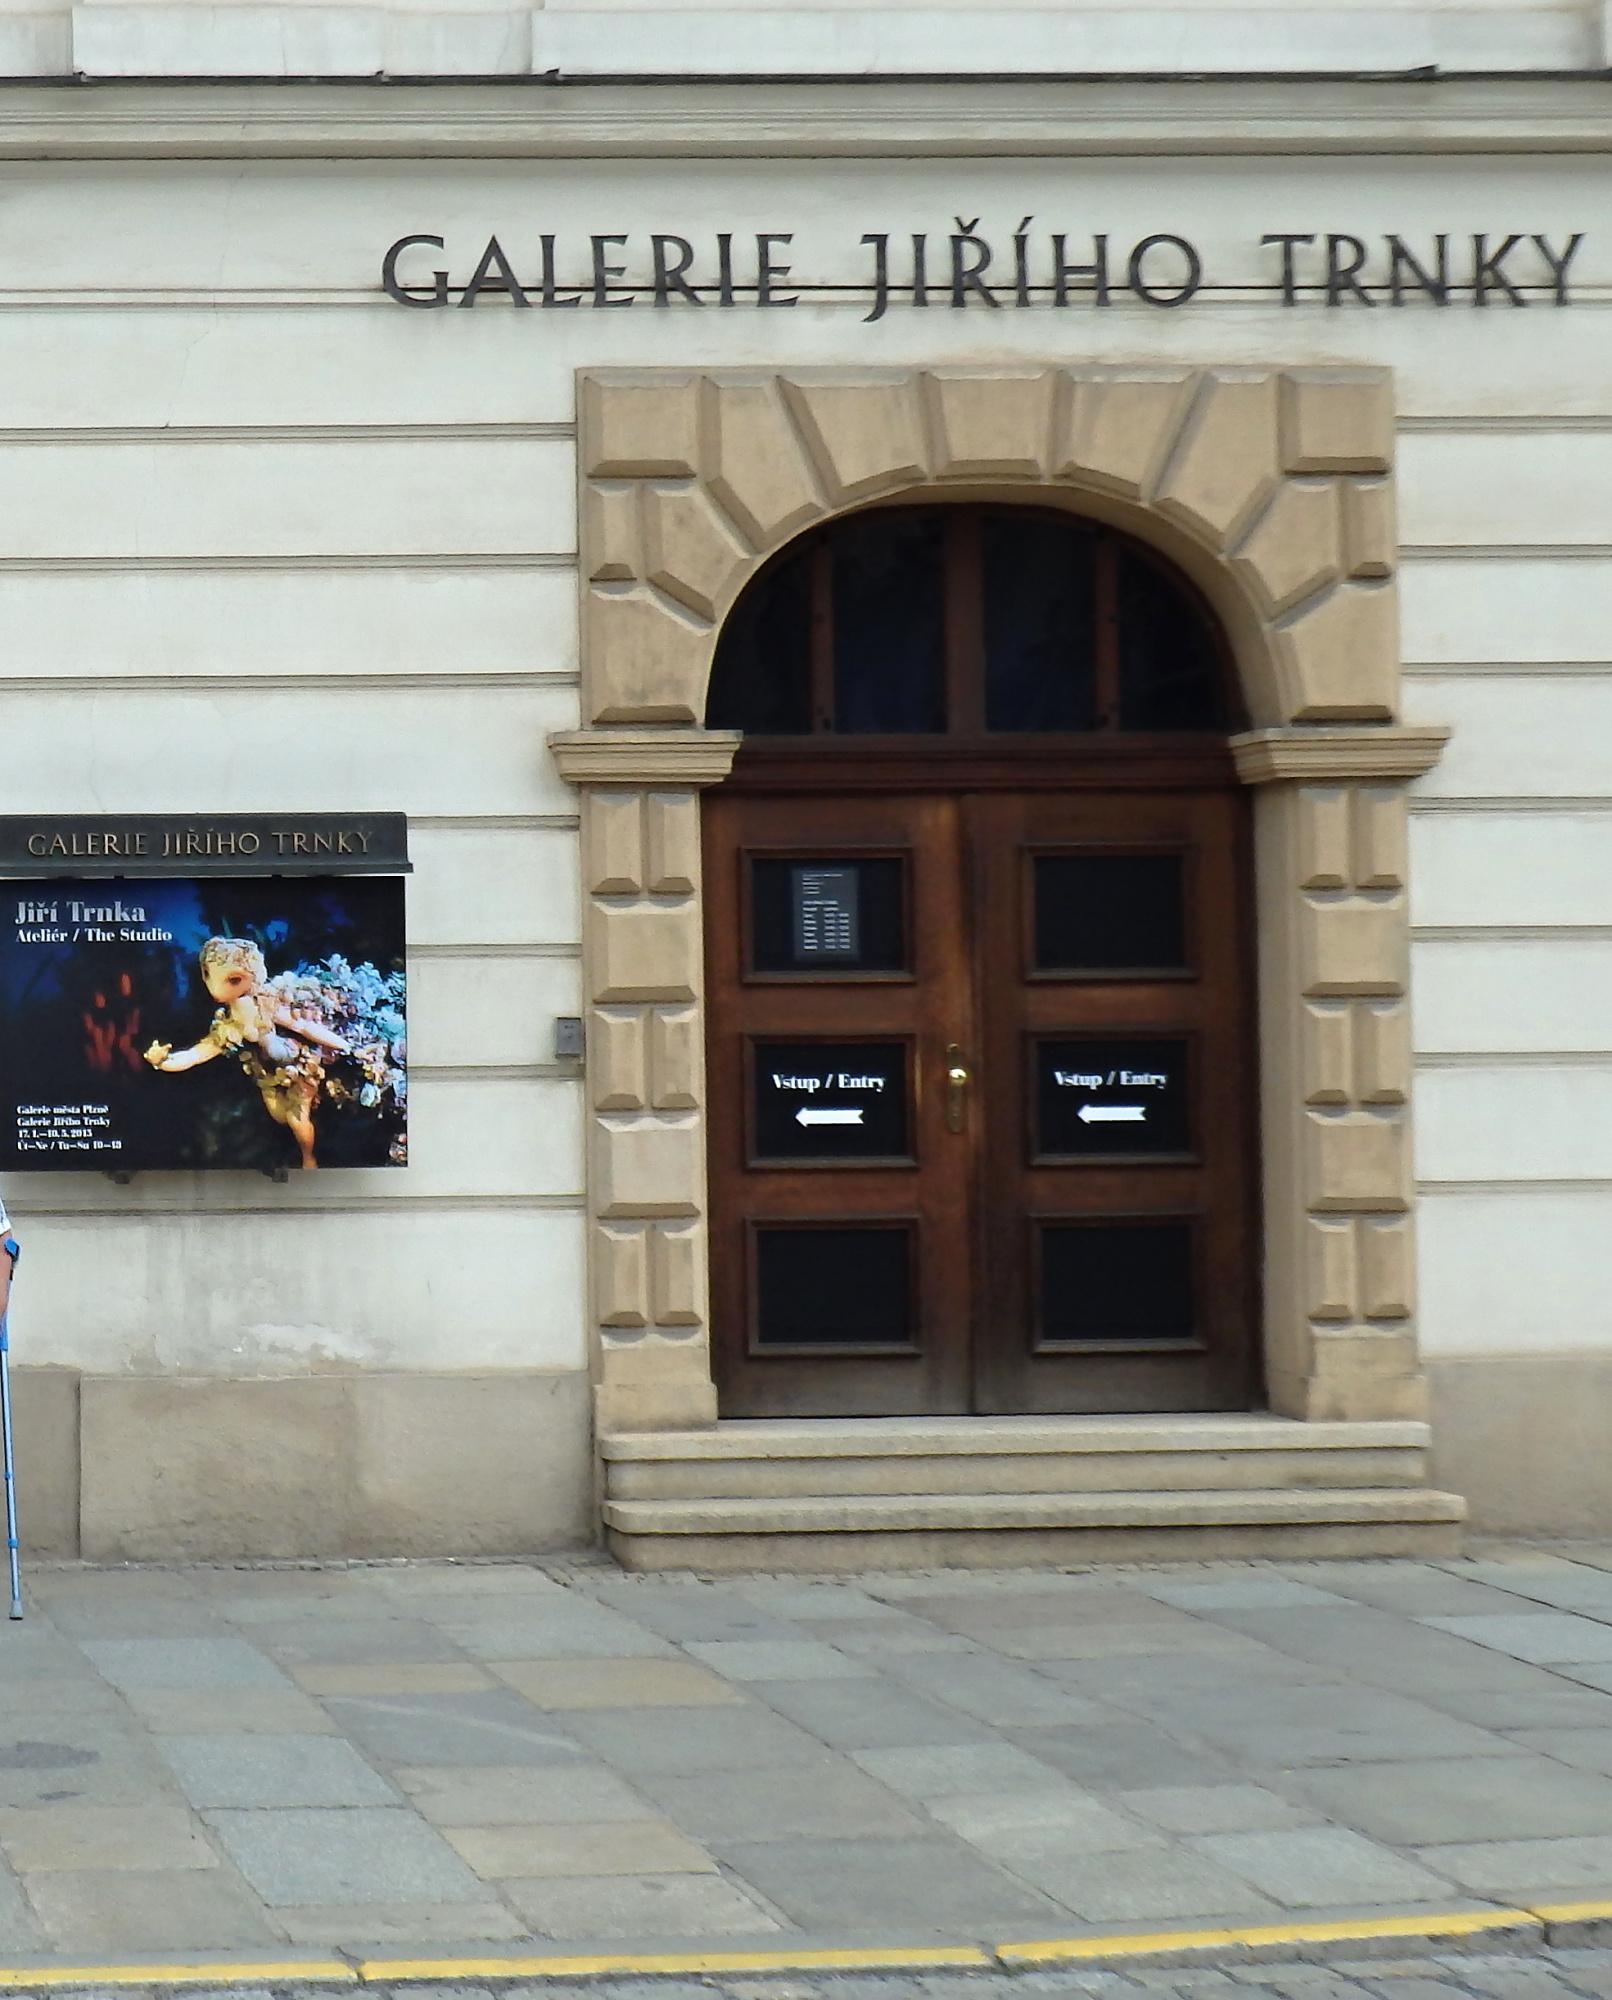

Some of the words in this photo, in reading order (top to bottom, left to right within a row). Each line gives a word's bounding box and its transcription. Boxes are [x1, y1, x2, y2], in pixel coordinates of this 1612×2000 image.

[382, 233, 801, 309] GALERIE
[859, 215, 1202, 323] JIŘÍHO
[1259, 232, 1586, 307] TRNKY
[28, 833, 149, 856] GALERIE
[161, 828, 261, 857] JIŘÍHO
[271, 831, 373, 854] TRNKY
[15, 901, 58, 925] Jiří
[66, 901, 147, 923] Trnka
[16, 928, 69, 943] Ateliér
[72, 928, 81, 943] /
[84, 928, 116, 942] The
[119, 928, 173, 942] Studio
[772, 1074, 821, 1093] Vstup
[824, 1074, 834, 1089] /
[838, 1073, 885, 1093] Entry
[1054, 1071, 1103, 1090] Vstup
[1106, 1071, 1116, 1086] /
[1120, 1071, 1167, 1090] Entry
[17, 1106, 51, 1115] Galerie
[17, 1117, 51, 1127] Galerie
[83, 1117, 111, 1128] Trnky
